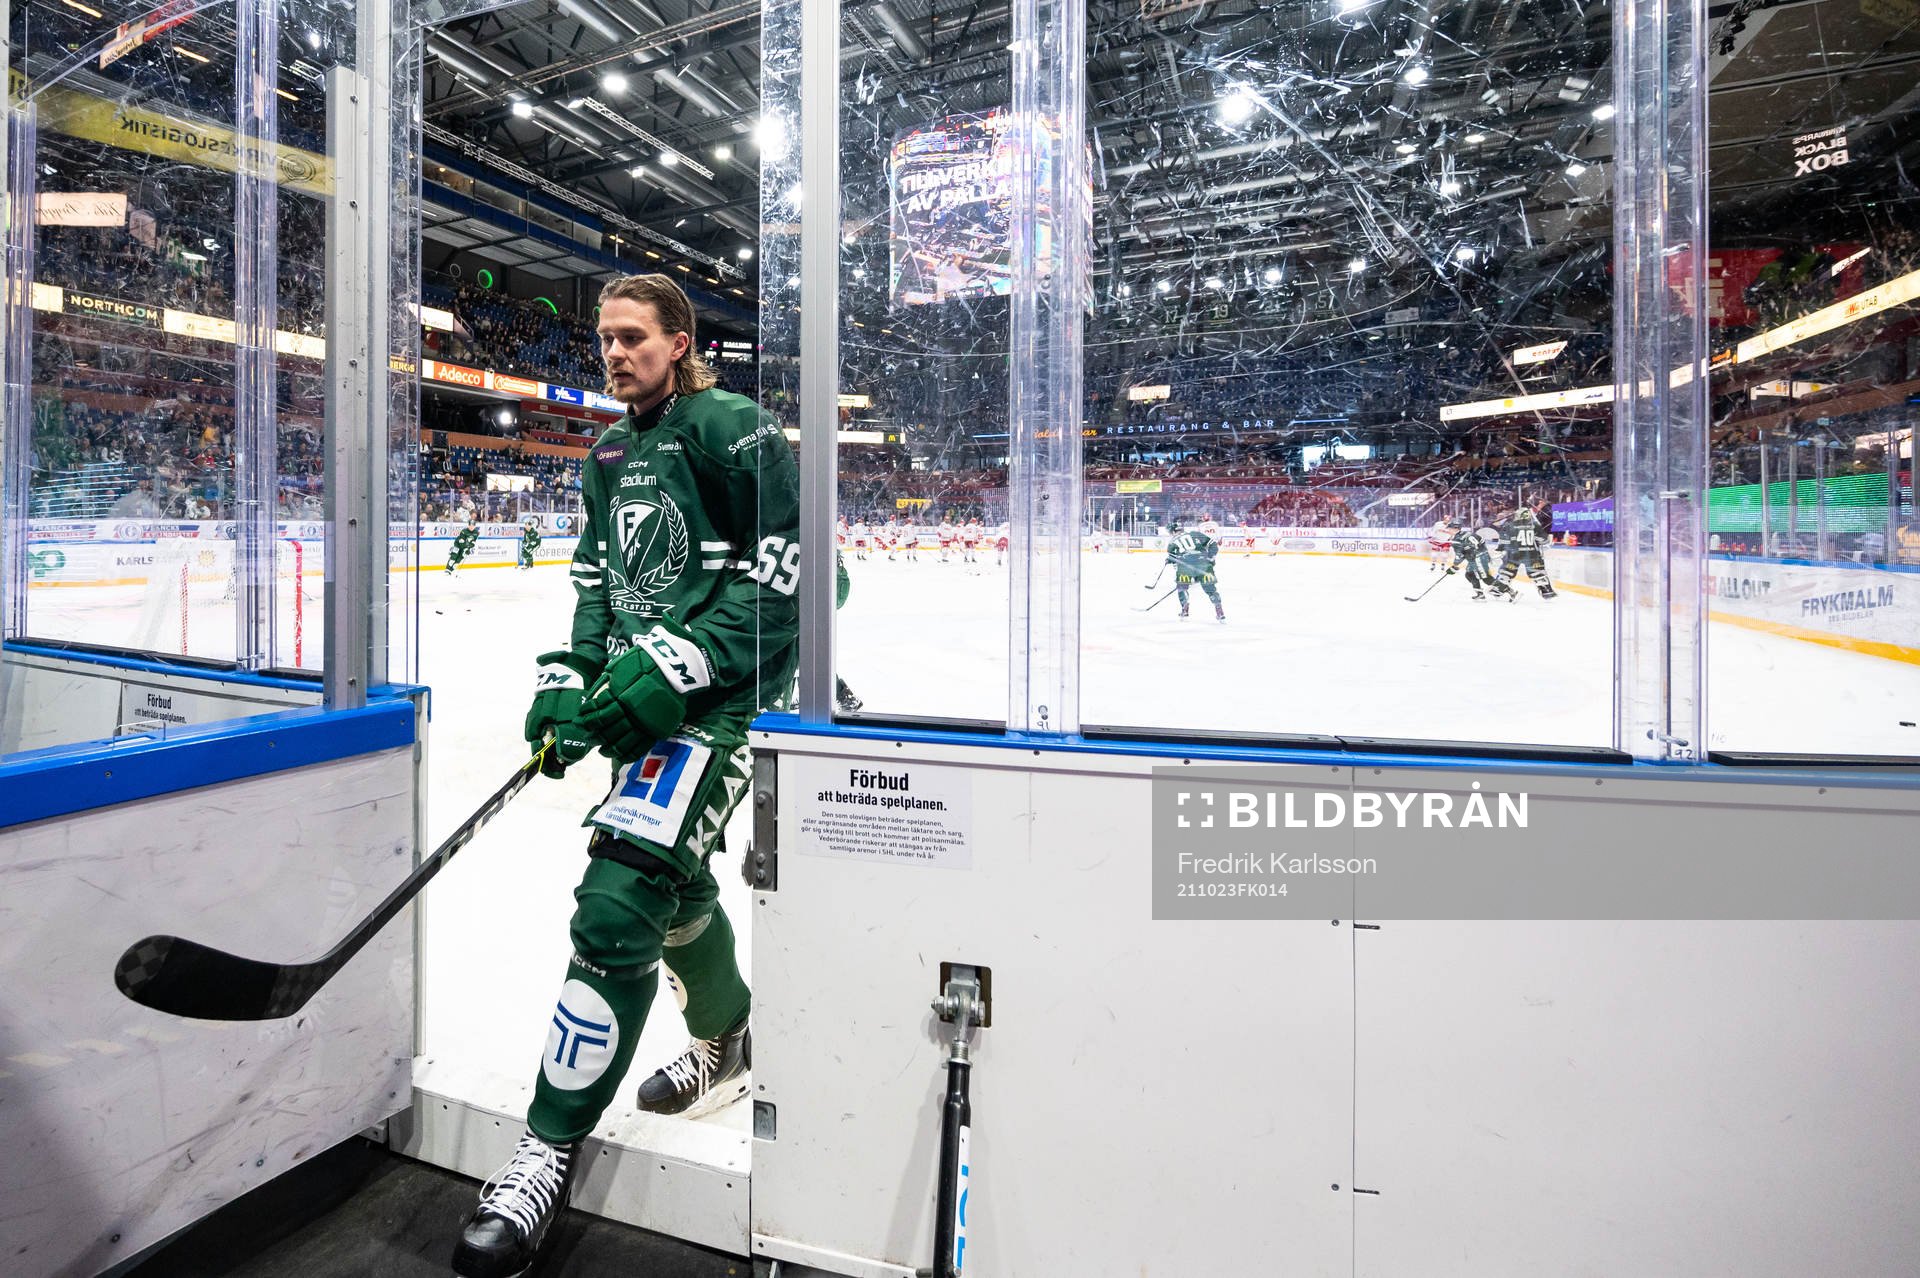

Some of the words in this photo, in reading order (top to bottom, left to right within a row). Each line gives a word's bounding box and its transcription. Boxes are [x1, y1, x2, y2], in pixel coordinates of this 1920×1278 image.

[70, 295, 157, 321] NORTHCOM
[389, 360, 416, 374] BERGS
[440, 365, 481, 386] Adecco
[1106, 422, 1210, 435] RESTAURANG
[1221, 421, 1230, 429] &
[1243, 419, 1275, 428] BAR
[728, 434, 757, 455] Svema
[627, 461, 649, 469] CCM
[620, 473, 657, 488] stadium
[623, 511, 636, 546] F
[1174, 534, 1197, 553] 10
[1516, 529, 1535, 546] 40
[535, 547, 573, 557] LÖFBERG
[1382, 543, 1417, 553] BORGA
[611, 601, 652, 611] ARLSTAD
[1801, 584, 1895, 618] FRYKMALM
[147, 693, 172, 709] Förbud
[141, 708, 159, 719] beträda
[562, 738, 587, 748] CCM
[850, 769, 909, 791] Förbud
[817, 791, 834, 803] att
[836, 791, 878, 806] beträda
[880, 795, 948, 811] spelplanen.
[818, 819, 858, 828] angränsande
[888, 825, 910, 833] mellan
[849, 813, 877, 823] olovligen
[878, 816, 905, 824] beträder
[906, 819, 944, 828] spelplanen,
[813, 826, 822, 834] sig
[823, 827, 844, 836] skyldig
[855, 830, 870, 838] brott
[883, 833, 910, 841] kommer
[818, 835, 861, 845] Vederbörande
[899, 842, 924, 851] stängas
[829, 845, 856, 853] samtliga
[896, 850, 915, 858] under
[916, 851, 927, 859] två
